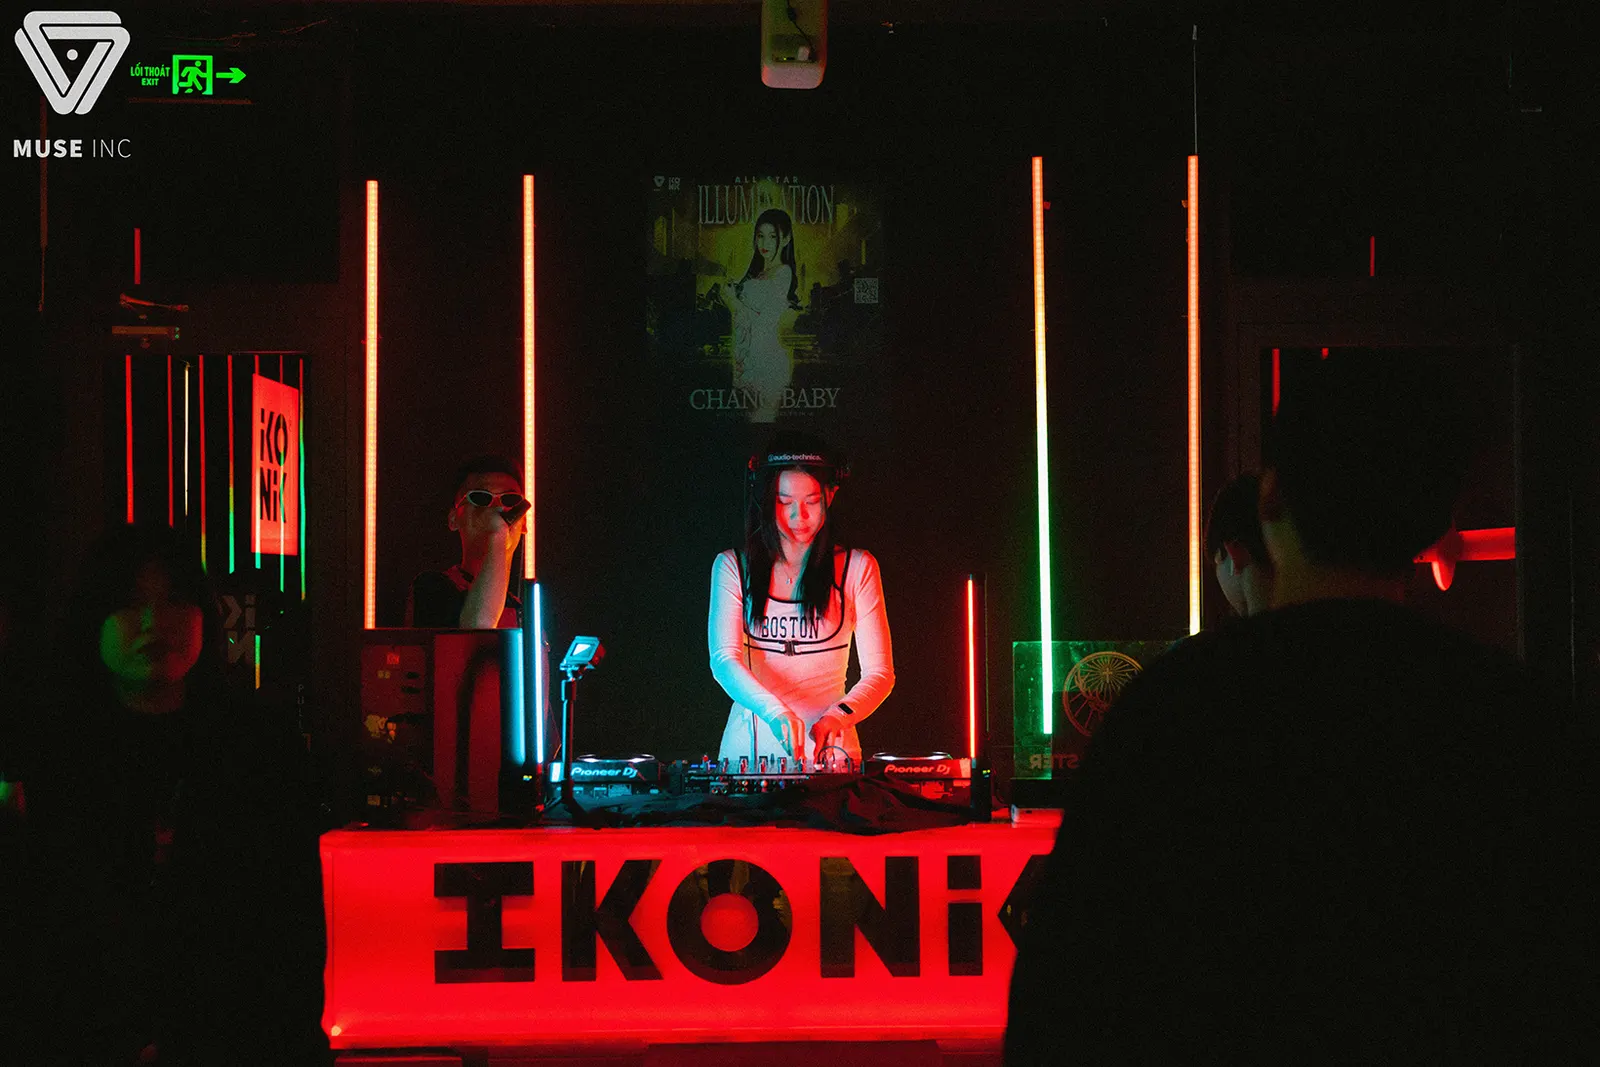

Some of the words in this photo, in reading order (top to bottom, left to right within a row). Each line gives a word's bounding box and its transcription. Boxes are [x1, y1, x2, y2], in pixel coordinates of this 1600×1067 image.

[144, 63, 171, 77] THOÁT
[141, 77, 160, 86] EXIT
[734, 175, 757, 184] ALL
[766, 175, 799, 184] STAR
[780, 387, 841, 409] BABY
[761, 616, 819, 639] BOSTON
[570, 766, 622, 777] Pioneer
[883, 763, 936, 774] Pioneer
